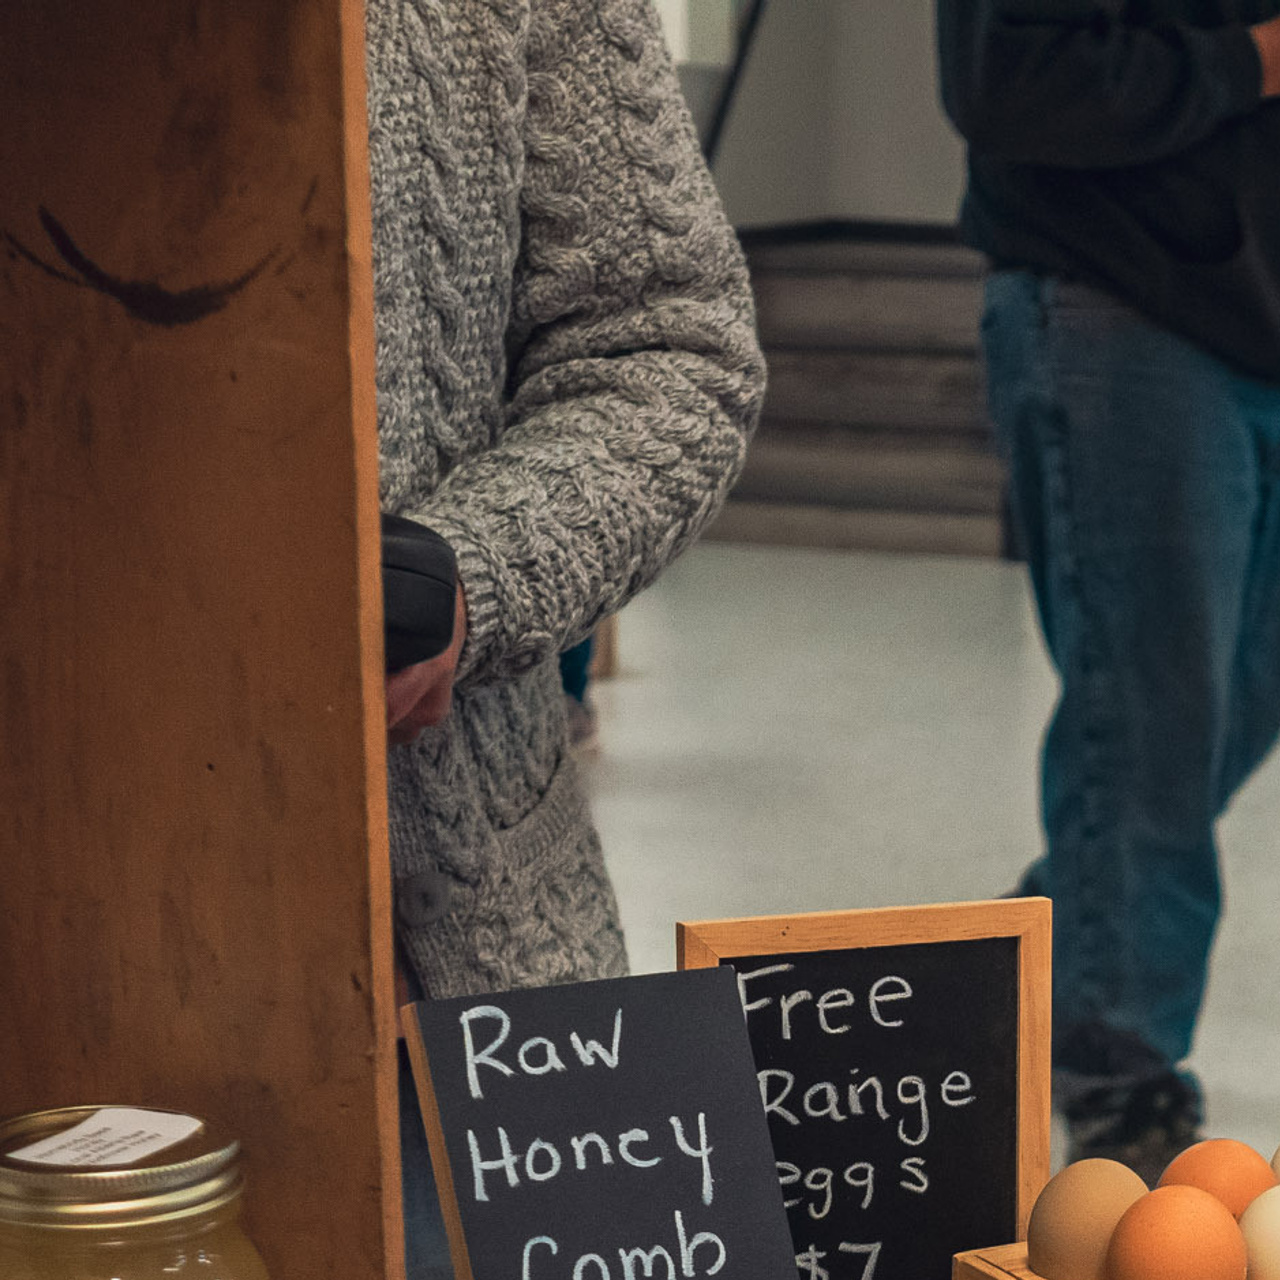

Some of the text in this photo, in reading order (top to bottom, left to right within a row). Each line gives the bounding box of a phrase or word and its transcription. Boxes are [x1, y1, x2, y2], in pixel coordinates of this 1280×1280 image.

[737, 963, 914, 1040] Free
[460, 1004, 623, 1100] Raw
[757, 1066, 977, 1147] Range
[467, 1112, 714, 1206] Honey
[775, 1156, 930, 1220] eggs
